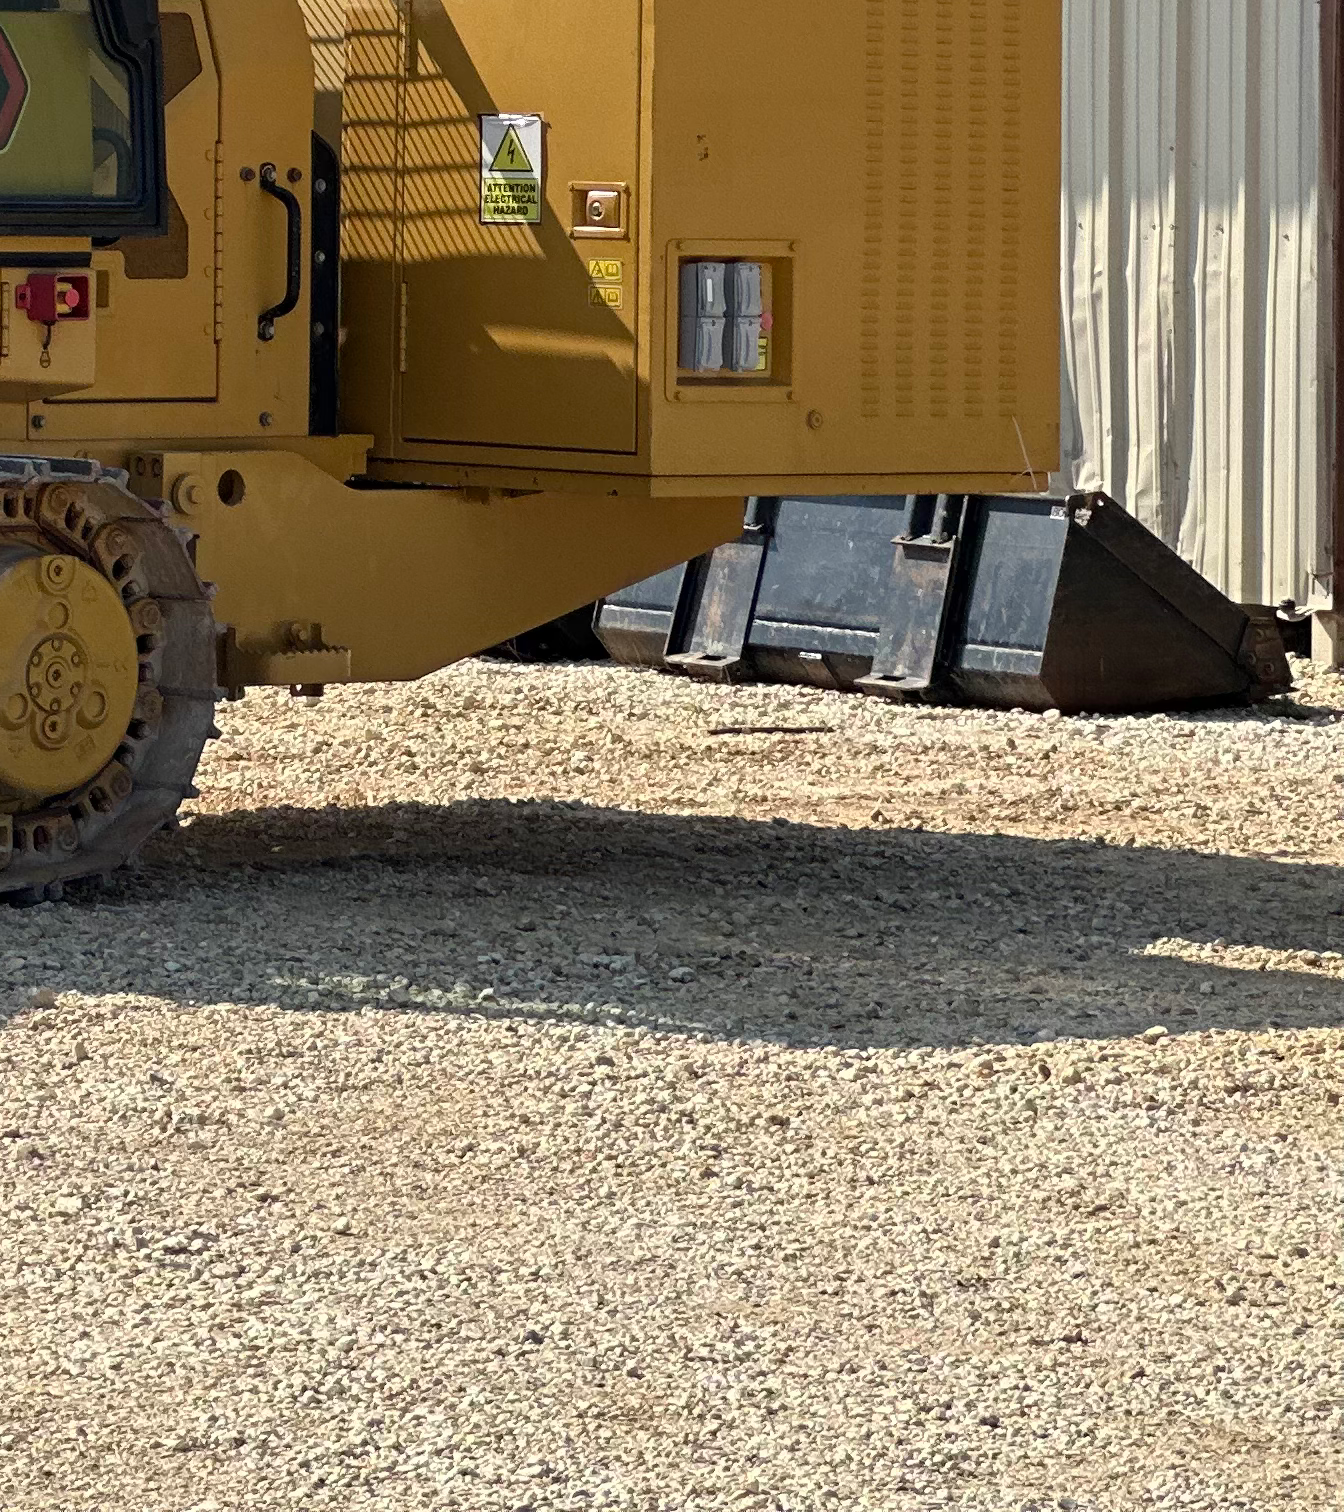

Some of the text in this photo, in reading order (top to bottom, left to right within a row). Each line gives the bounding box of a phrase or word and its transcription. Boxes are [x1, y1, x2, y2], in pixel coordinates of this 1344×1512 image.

[487, 183, 536, 193] ATTENTION
[484, 194, 538, 204] ELECTRICAL
[493, 205, 529, 216] HAZARD
